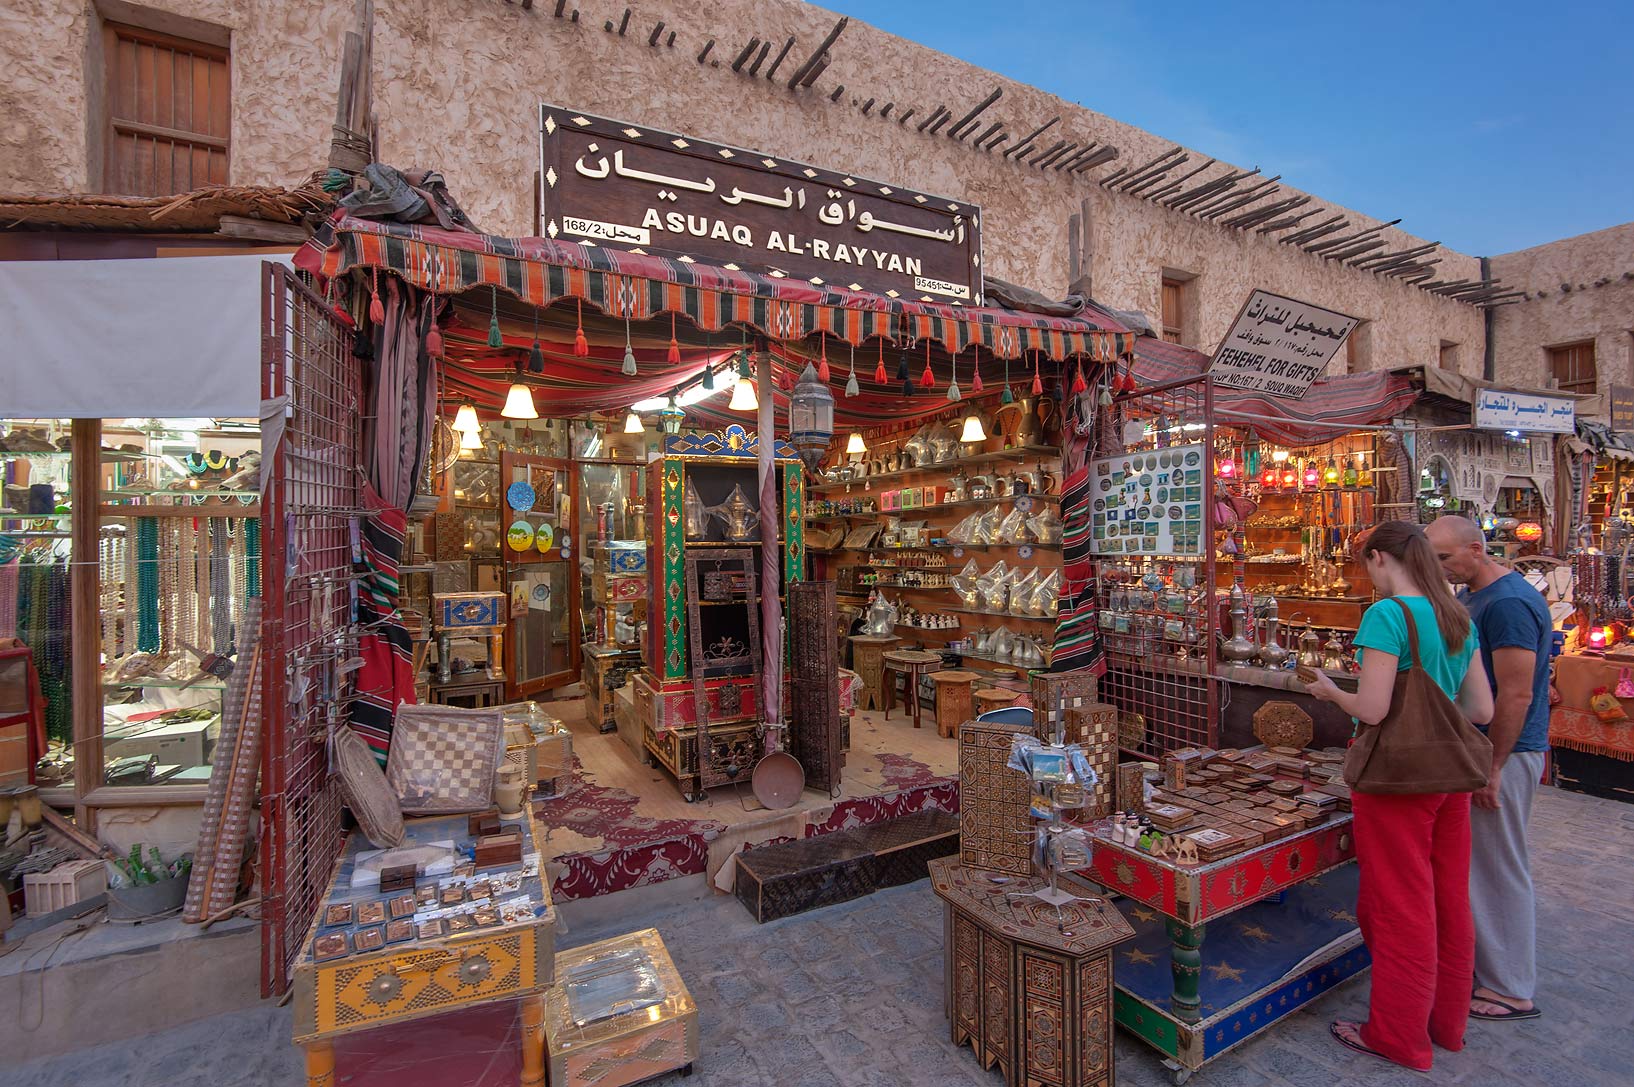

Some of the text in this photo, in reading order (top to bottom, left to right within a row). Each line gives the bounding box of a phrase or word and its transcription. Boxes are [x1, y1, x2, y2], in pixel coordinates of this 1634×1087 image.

[575, 142, 965, 245] أسواق الريان
[641, 208, 922, 276] ASUAQ AL-RAYYAN
[1247, 299, 1291, 326] للتراث
[1265, 358, 1289, 376] FOR
[1287, 363, 1319, 382] GIFTS
[1265, 381, 1285, 392] SOUQ
[1550, 402, 1573, 418] متجر
